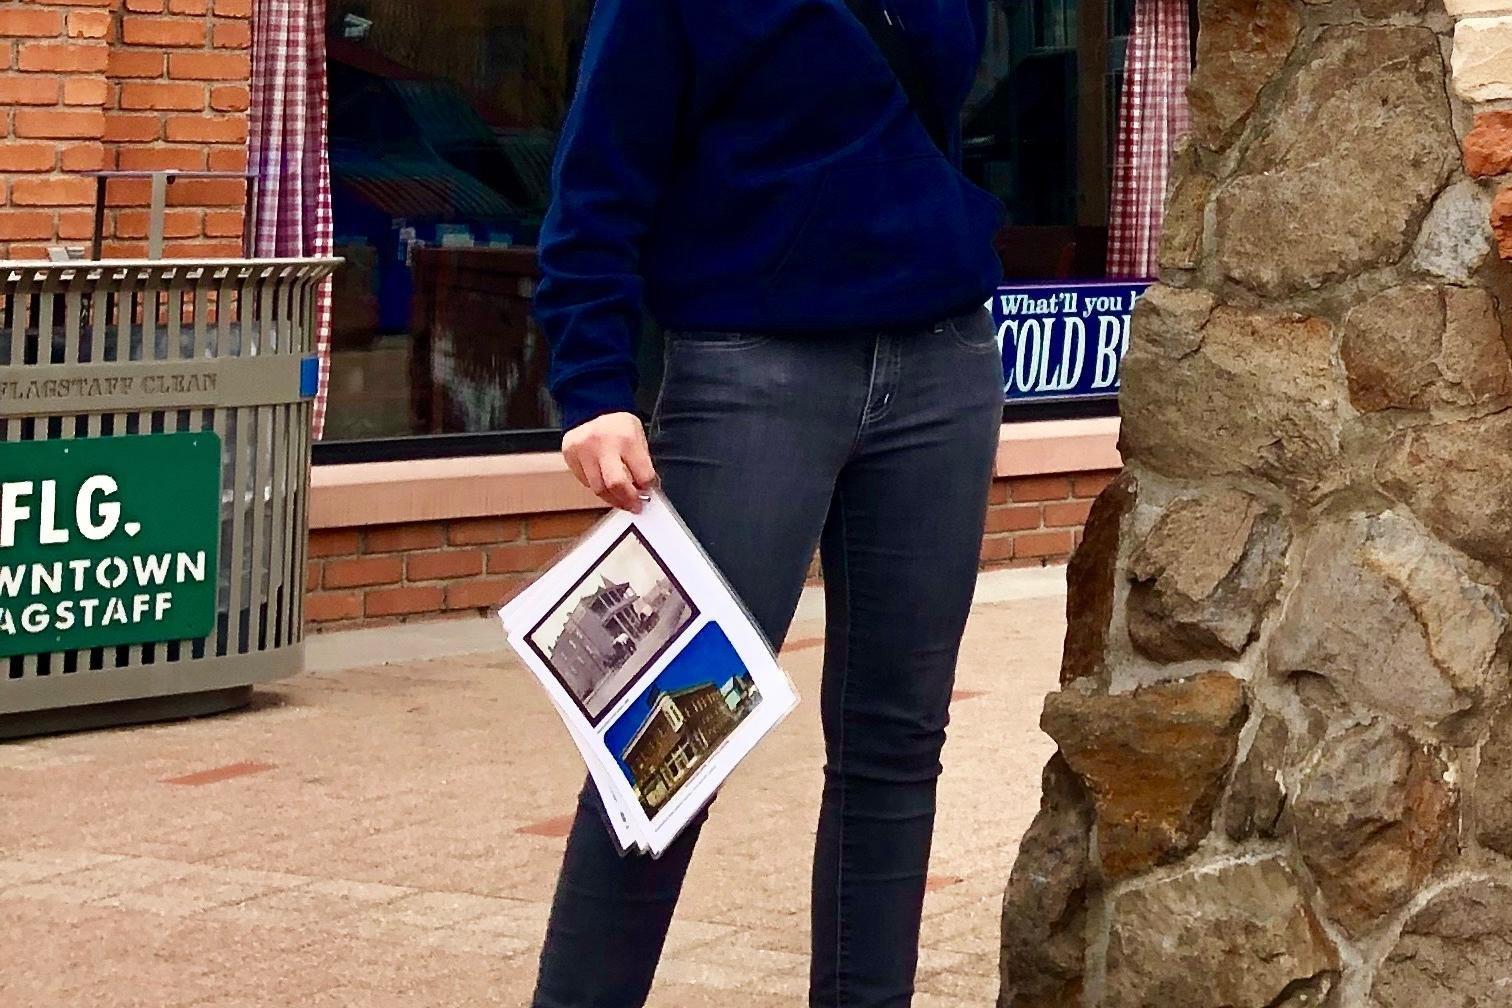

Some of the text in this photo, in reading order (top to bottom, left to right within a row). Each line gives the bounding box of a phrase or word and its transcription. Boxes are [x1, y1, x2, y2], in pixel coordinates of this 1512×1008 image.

[1000, 292, 1078, 315] What'll
[1083, 296, 1123, 317] you
[998, 316, 1086, 393] COLD
[141, 372, 218, 394] CLEAN
